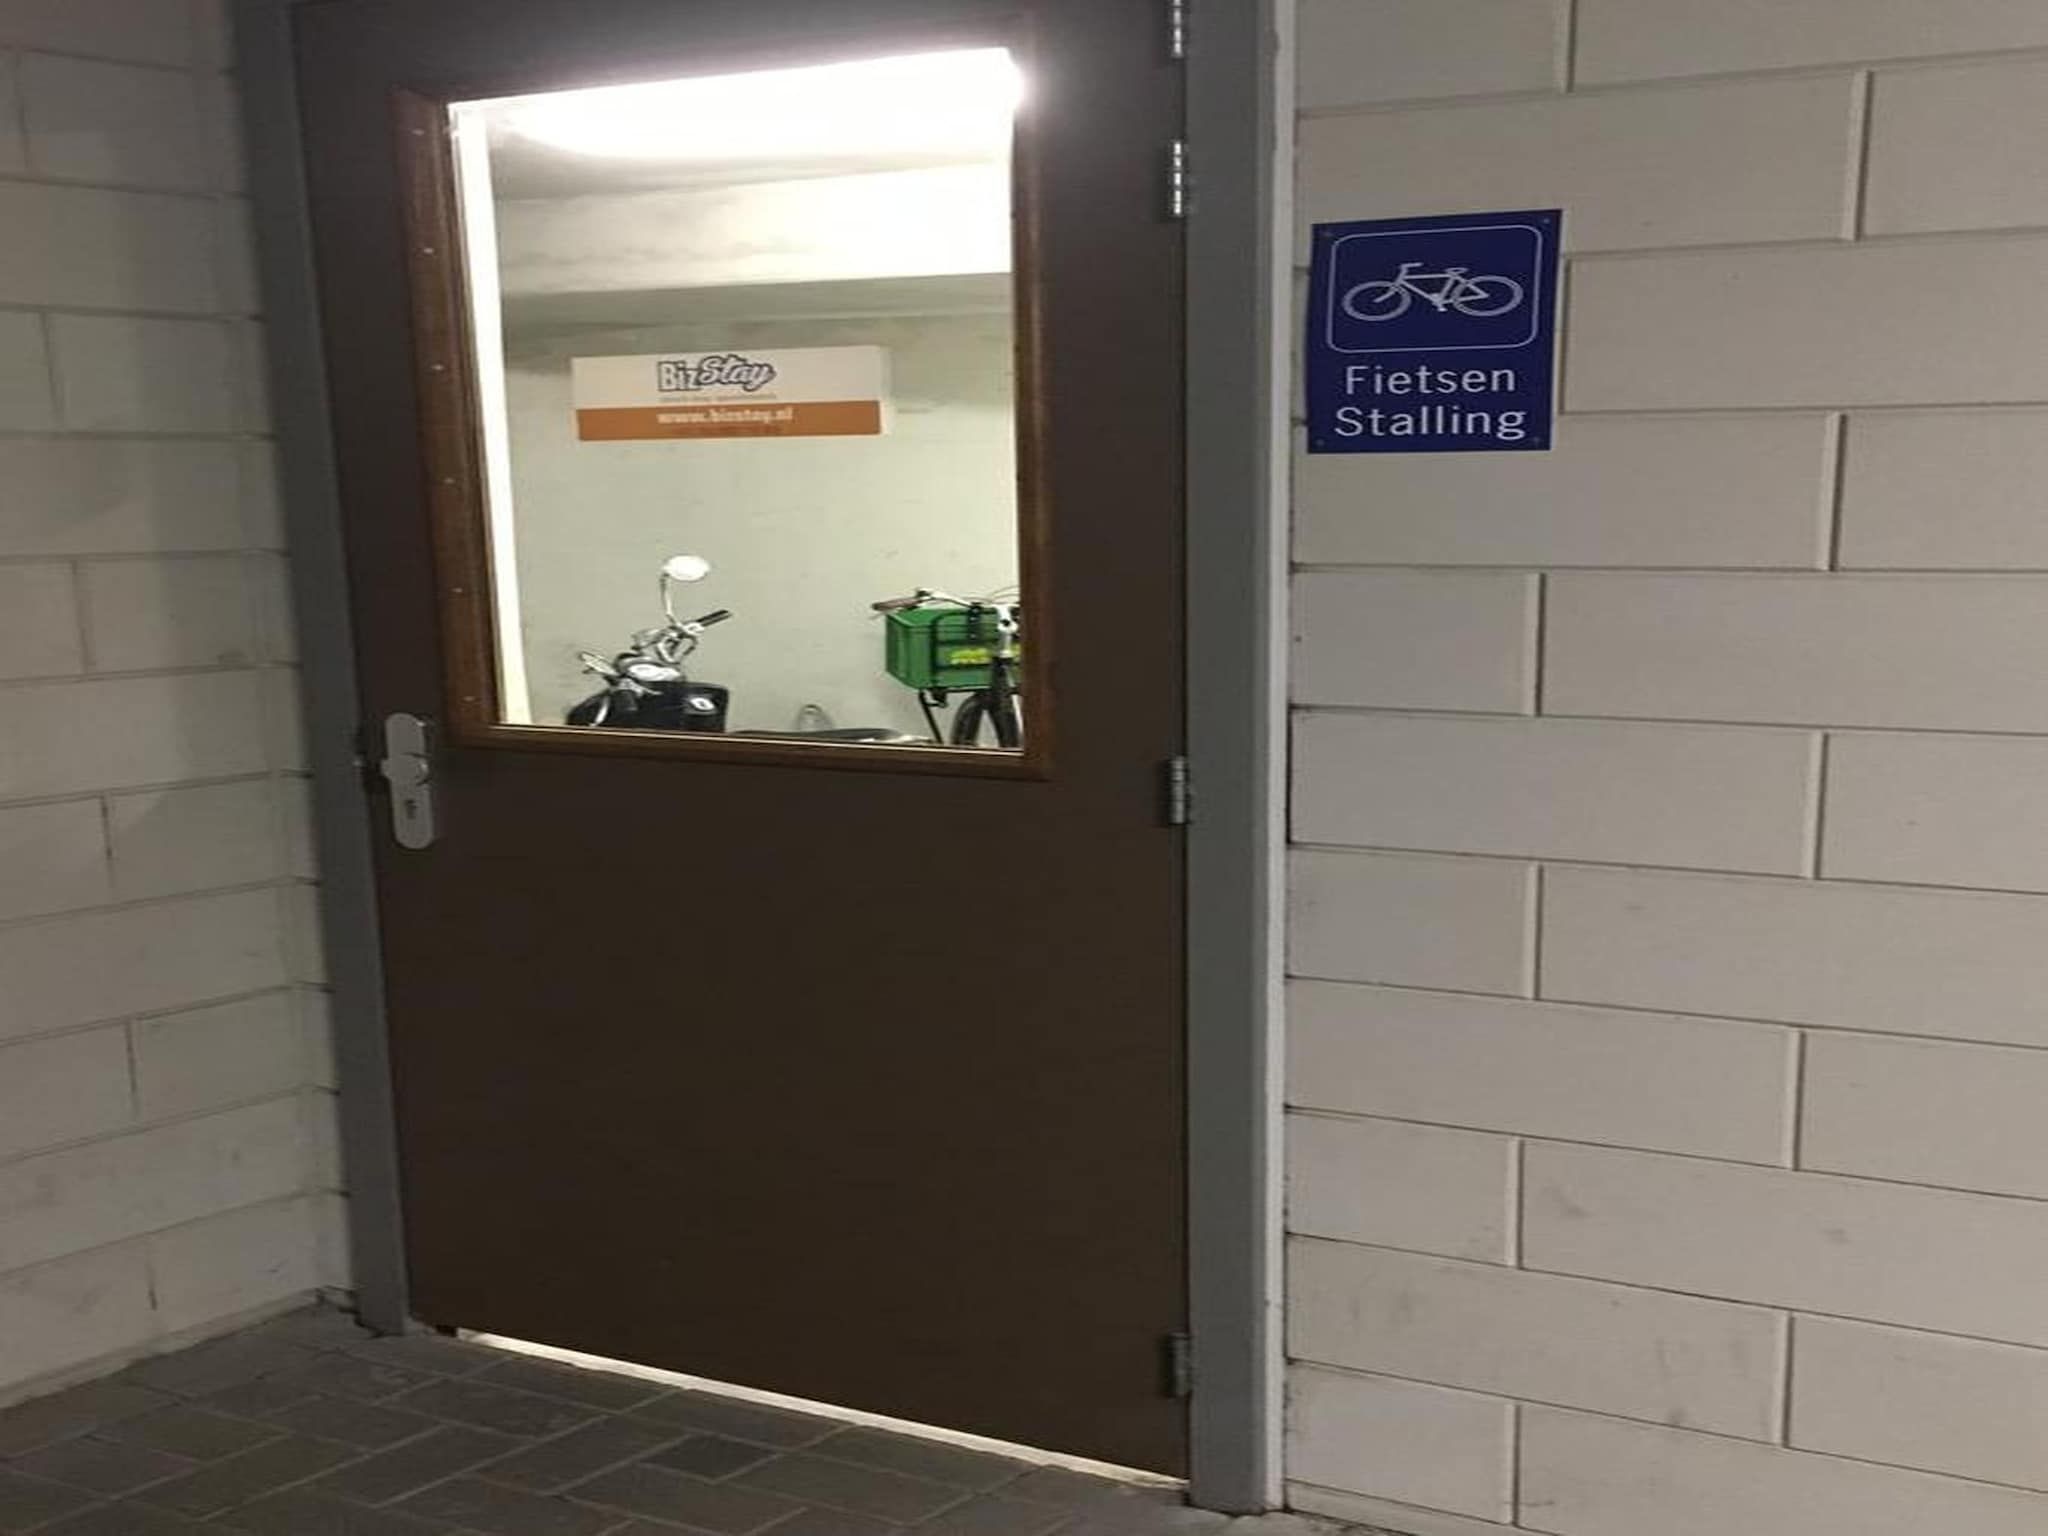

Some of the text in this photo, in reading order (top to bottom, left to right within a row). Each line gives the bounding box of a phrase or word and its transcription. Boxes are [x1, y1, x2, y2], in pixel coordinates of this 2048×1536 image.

[657, 354, 776, 391] BizStay
[1346, 366, 1515, 394] Fietsen
[1334, 406, 1526, 440] Stalling
